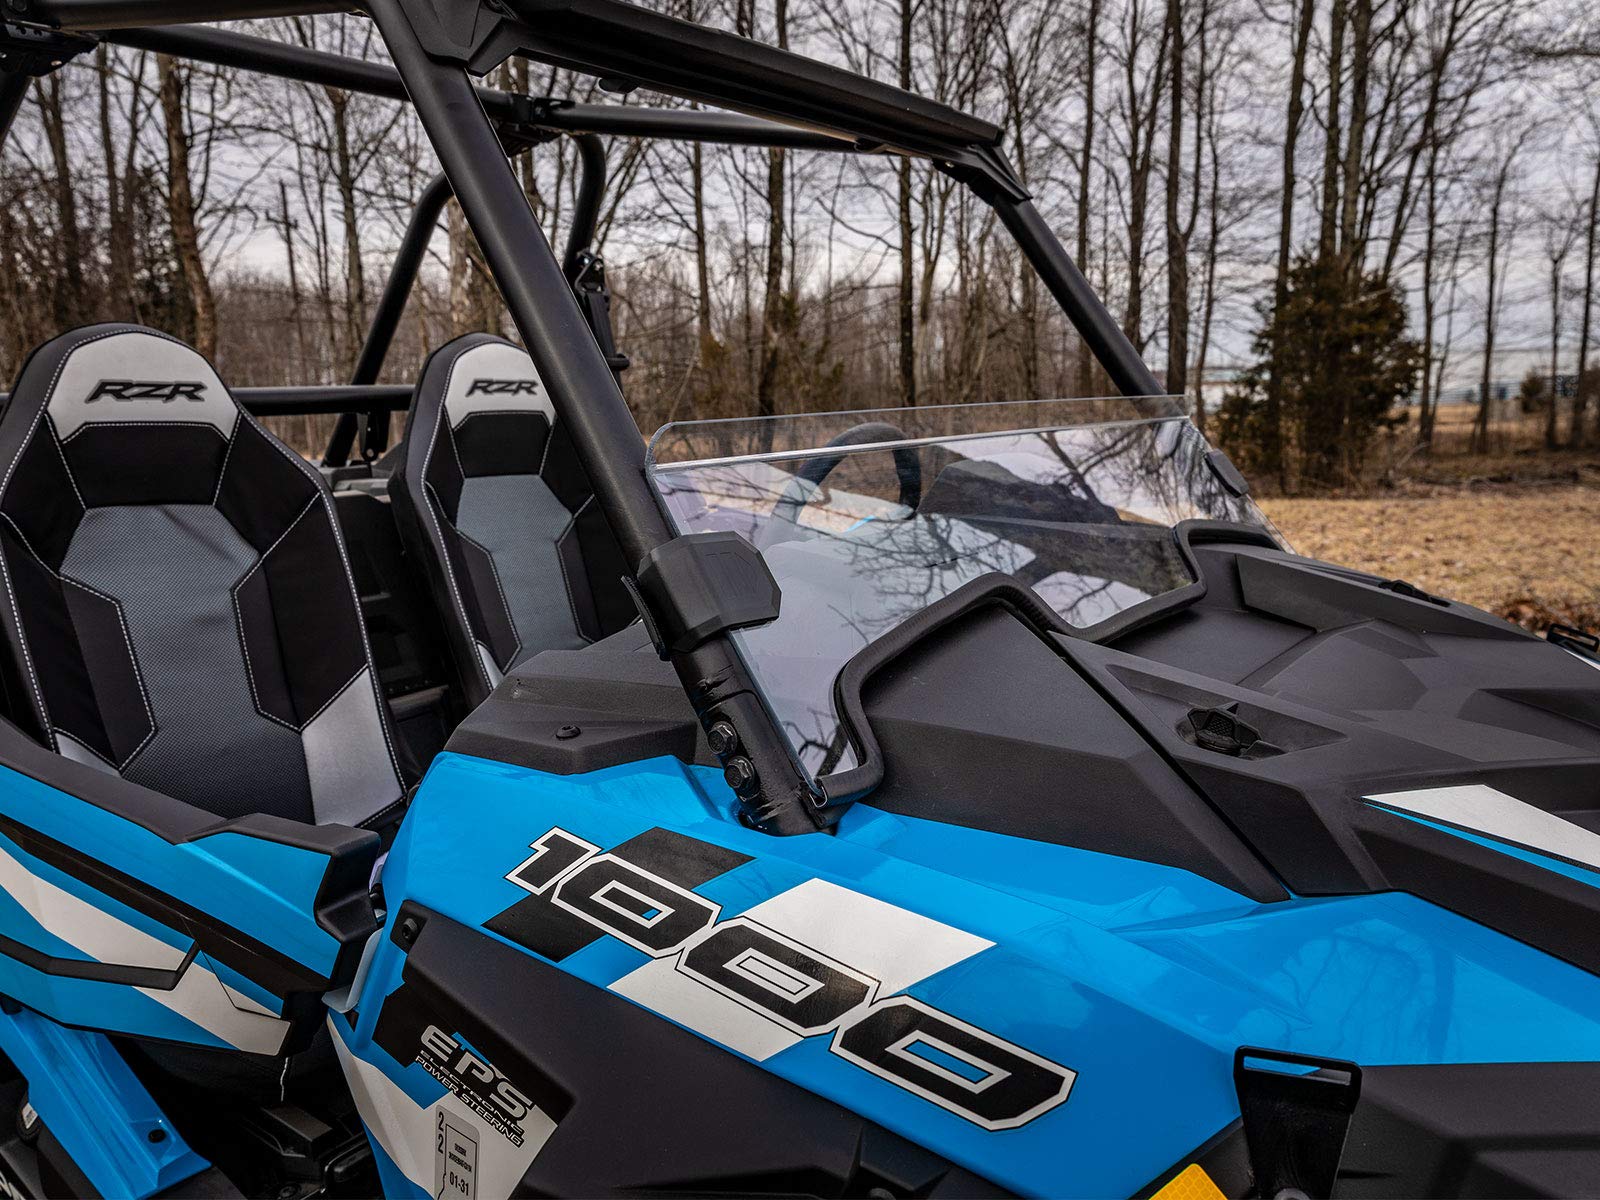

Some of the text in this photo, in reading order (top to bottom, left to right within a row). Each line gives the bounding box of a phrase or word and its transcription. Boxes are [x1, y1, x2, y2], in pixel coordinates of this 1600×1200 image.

[85, 379, 207, 403] RZR
[465, 379, 538, 397] RZR
[505, 826, 1077, 1131] 1000
[415, 1055, 521, 1146] POWER STEERING
[420, 1050, 523, 1135] ELECTRONIC
[421, 1025, 532, 1118] EPS
[450, 1171, 469, 1196] 01-31
